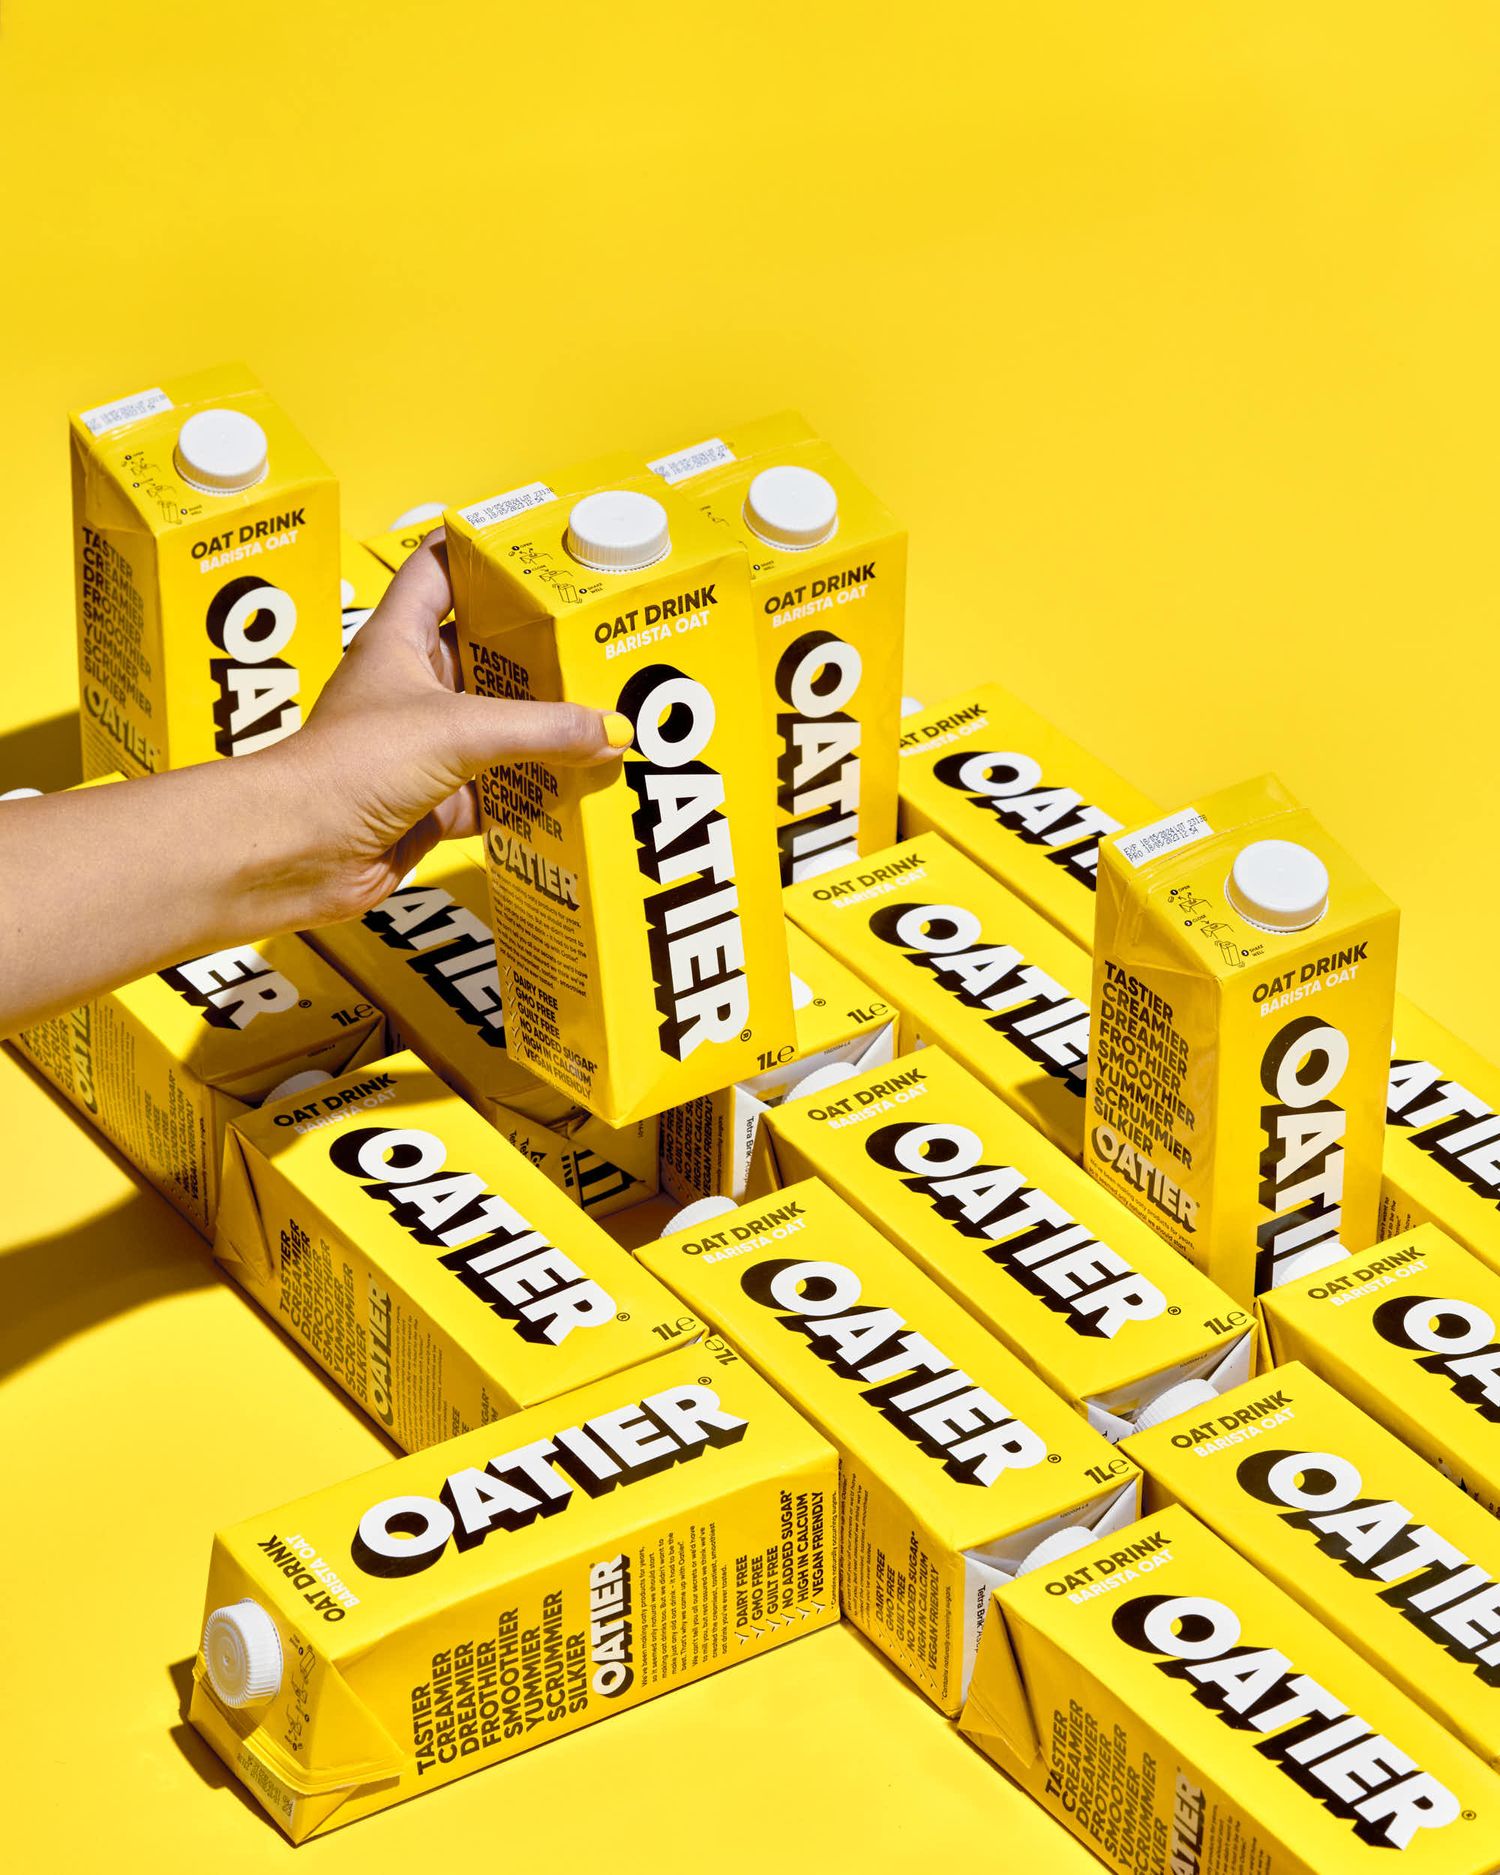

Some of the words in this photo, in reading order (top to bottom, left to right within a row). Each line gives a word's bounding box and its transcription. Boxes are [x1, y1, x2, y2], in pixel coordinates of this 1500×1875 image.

[82, 526, 133, 578] TASTIER
[191, 531, 234, 559] OAT
[239, 508, 306, 543] DRINK
[200, 541, 263, 574] BARISTA
[265, 530, 298, 550] OAT
[83, 547, 145, 609] CREAMIER
[83, 565, 145, 632] DREAMIER
[764, 586, 806, 614] OAT
[812, 561, 875, 598] DRINK
[772, 596, 833, 628] BARISTA
[836, 584, 868, 605] OAT
[83, 583, 142, 649] FROTHIER
[83, 601, 152, 683] SMOOTHIER
[594, 609, 639, 644] OAT
[644, 583, 719, 626] DRINK
[605, 623, 672, 660] BARISTA
[675, 610, 711, 634] OAT
[83, 619, 140, 683] YUMMIER
[84, 638, 152, 719] SCRUMMIER
[206, 576, 301, 758] OAT
[469, 641, 530, 690] TASTIER
[84, 655, 126, 710] SILKIER
[900, 732, 920, 748] AT
[921, 703, 988, 738] DRINK
[775, 629, 862, 886] OATI
[481, 774, 563, 841] SCRUMMIER
[483, 795, 533, 843] SILKIER
[933, 751, 1126, 892] OAT
[487, 825, 580, 911] OATIER
[617, 663, 752, 1063] OATIER
[813, 880, 855, 901] OAT
[857, 853, 926, 887] DRINK
[831, 882, 894, 909] BARISTA
[895, 868, 928, 888] OAT
[513, 970, 536, 997] DAIRY
[538, 988, 558, 1010] FREE
[869, 902, 1091, 1098] OATIE
[1105, 960, 1174, 1023] TASTIER
[1252, 970, 1296, 1003] OAT
[1300, 941, 1368, 983] DRINK
[1260, 980, 1322, 1017] BARISTA
[1326, 965, 1359, 987] OAT
[515, 987, 535, 1009] GMO
[536, 1002, 556, 1023] FREE
[518, 1002, 539, 1026] GUILT
[540, 1018, 560, 1040] FREE
[1103, 983, 1189, 1060] CREAMIER
[1100, 1019, 1181, 1096] FROTHIER
[1101, 1000, 1188, 1080] DREAMIER
[273, 1103, 321, 1127] OAT
[321, 1072, 397, 1110] DRINK
[294, 1105, 363, 1135] BARISTA
[363, 1089, 397, 1108] OAT
[807, 1098, 853, 1121] OAT
[853, 1068, 927, 1106] DRINK
[827, 1100, 896, 1129] BARISTA
[894, 1083, 928, 1103] OAT
[1097, 1056, 1174, 1132] YUMMIER
[1098, 1039, 1195, 1131] SMOOTHIER
[746, 1116, 754, 1139] Tetra
[1094, 1077, 1192, 1170] SCRUMMIER
[1094, 1096, 1153, 1157] SILKIER
[1091, 1125, 1197, 1233] OATIER
[1254, 1015, 1349, 1297] OATI
[329, 1126, 618, 1347] OATIER
[681, 1232, 729, 1255] OAT
[730, 1201, 806, 1241] DRINK
[702, 1235, 773, 1264] BARISTA
[772, 1218, 807, 1239] OAT
[865, 1121, 1168, 1340] OATIER
[280, 1229, 290, 1313] TASTIER
[289, 1218, 299, 1327] CREAMIER
[300, 1230, 311, 1342] DREAMIER
[311, 1248, 323, 1354] FROTHIER
[1307, 1276, 1354, 1299] OAT
[1353, 1246, 1426, 1281] DRINK
[1329, 1275, 1395, 1306] BARISTA
[1395, 1261, 1429, 1278] OAT
[320, 1238, 333, 1366] SMOOTHIER
[334, 1277, 344, 1375] YUMMIER
[343, 1262, 356, 1392] SCRUMMIER
[356, 1323, 368, 1403] SILKIER
[740, 1258, 1048, 1488] OATIER
[1171, 1421, 1218, 1448] OAT
[1217, 1390, 1293, 1430] DRINK
[1193, 1424, 1262, 1457] BARISTA
[1260, 1408, 1295, 1430] OAT
[351, 1384, 750, 1579] OATIER
[286, 1533, 317, 1559] OAT
[796, 1493, 808, 1553] CALCIUM
[811, 1492, 823, 1548] FRIENDLY
[257, 1534, 317, 1591] DRINK
[309, 1557, 361, 1609] BARISTA
[736, 1554, 748, 1587] FREE
[751, 1555, 763, 1587] FREE
[767, 1545, 778, 1577] FREE
[782, 1541, 794, 1587] ADDED
[797, 1554, 808, 1569] IN
[797, 1572, 808, 1603] HIGH
[812, 1551, 824, 1597] VEGAN
[876, 1548, 886, 1582] FREE
[886, 1565, 895, 1598] FREE
[896, 1571, 905, 1600] FREE
[919, 1551, 928, 1613] CALCIUM
[1045, 1567, 1094, 1595] OAT
[1093, 1531, 1172, 1575] DRINK
[1068, 1569, 1140, 1605] BARISTA
[1138, 1549, 1174, 1572] OAT
[1236, 1449, 1500, 1688] OATIE
[303, 1590, 346, 1622] OAT
[736, 1591, 748, 1628] DAIRY
[752, 1588, 763, 1621] GMO
[767, 1578, 778, 1615] GUILT
[782, 1588, 793, 1610] NO
[875, 1583, 885, 1623] DAIRY
[885, 1599, 895, 1632] GMO
[895, 1602, 904, 1641] GUILT
[908, 1586, 917, 1631] ADDED
[918, 1614, 926, 1627] IN
[930, 1564, 940, 1620] FRIENDLY
[977, 1585, 986, 1608] Tetra
[589, 1553, 634, 1698] OATIER
[906, 1634, 916, 1652] NO
[917, 1630, 927, 1663] HIGH
[928, 1622, 938, 1671] VEGAN
[499, 1607, 524, 1739] SMOOTHIER
[521, 1625, 545, 1733] YUMMIER
[543, 1590, 567, 1722] SCRUMMIER
[566, 1631, 588, 1714] SILKIER
[432, 1648, 457, 1764] CREAMIER
[454, 1640, 480, 1757] DREAMIER
[477, 1638, 502, 1749] FROTHIER
[1111, 1593, 1461, 1851] OATIER
[411, 1682, 436, 1776] TASTIER
[1045, 1709, 1068, 1798] TASTIER
[1062, 1699, 1083, 1813] CREAMIER
[1075, 1712, 1098, 1830] DREAMIER
[1089, 1733, 1112, 1845] FROTHIER
[1103, 1723, 1127, 1858] SMOOTHIER
[1118, 1765, 1140, 1870] YUMMIER
[1170, 1772, 1206, 1875] ATIER
